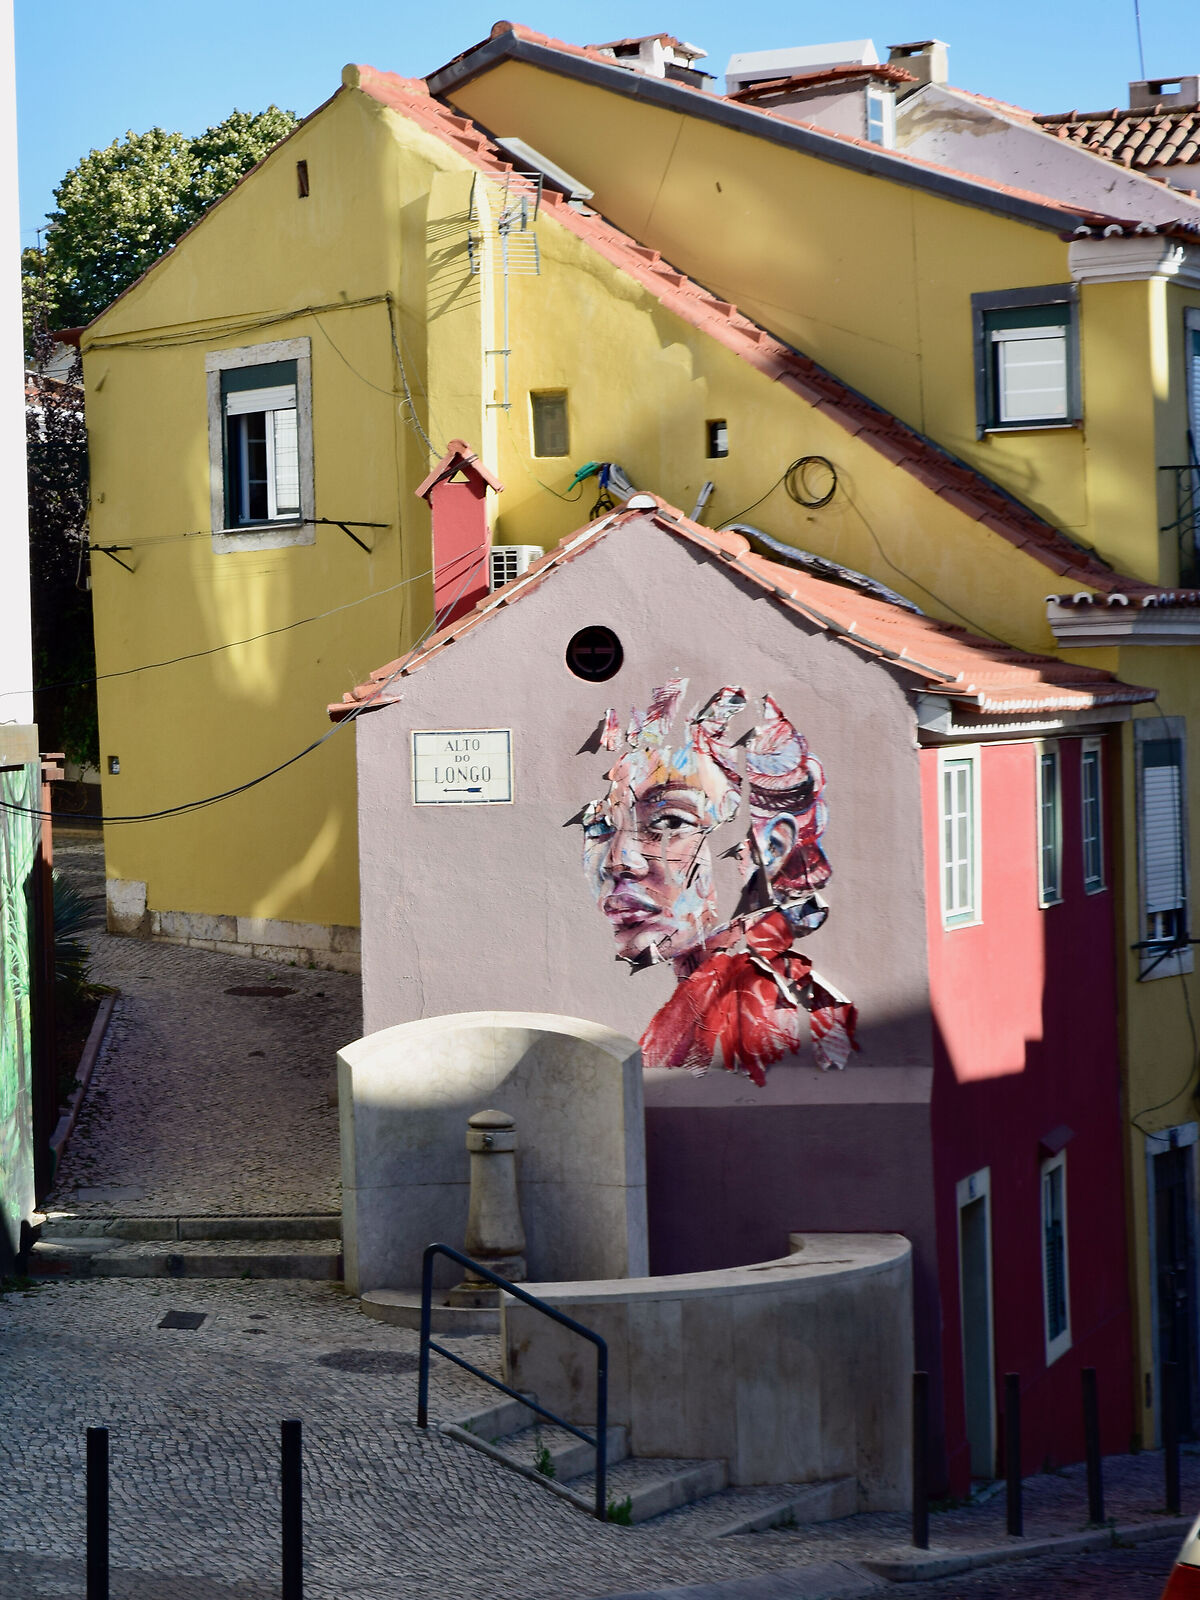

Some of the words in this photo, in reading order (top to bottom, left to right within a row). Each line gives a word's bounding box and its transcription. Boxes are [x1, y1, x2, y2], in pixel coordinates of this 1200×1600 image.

[444, 739, 480, 752] ALTO
[455, 754, 471, 763] DO
[434, 765, 491, 784] LONGO
